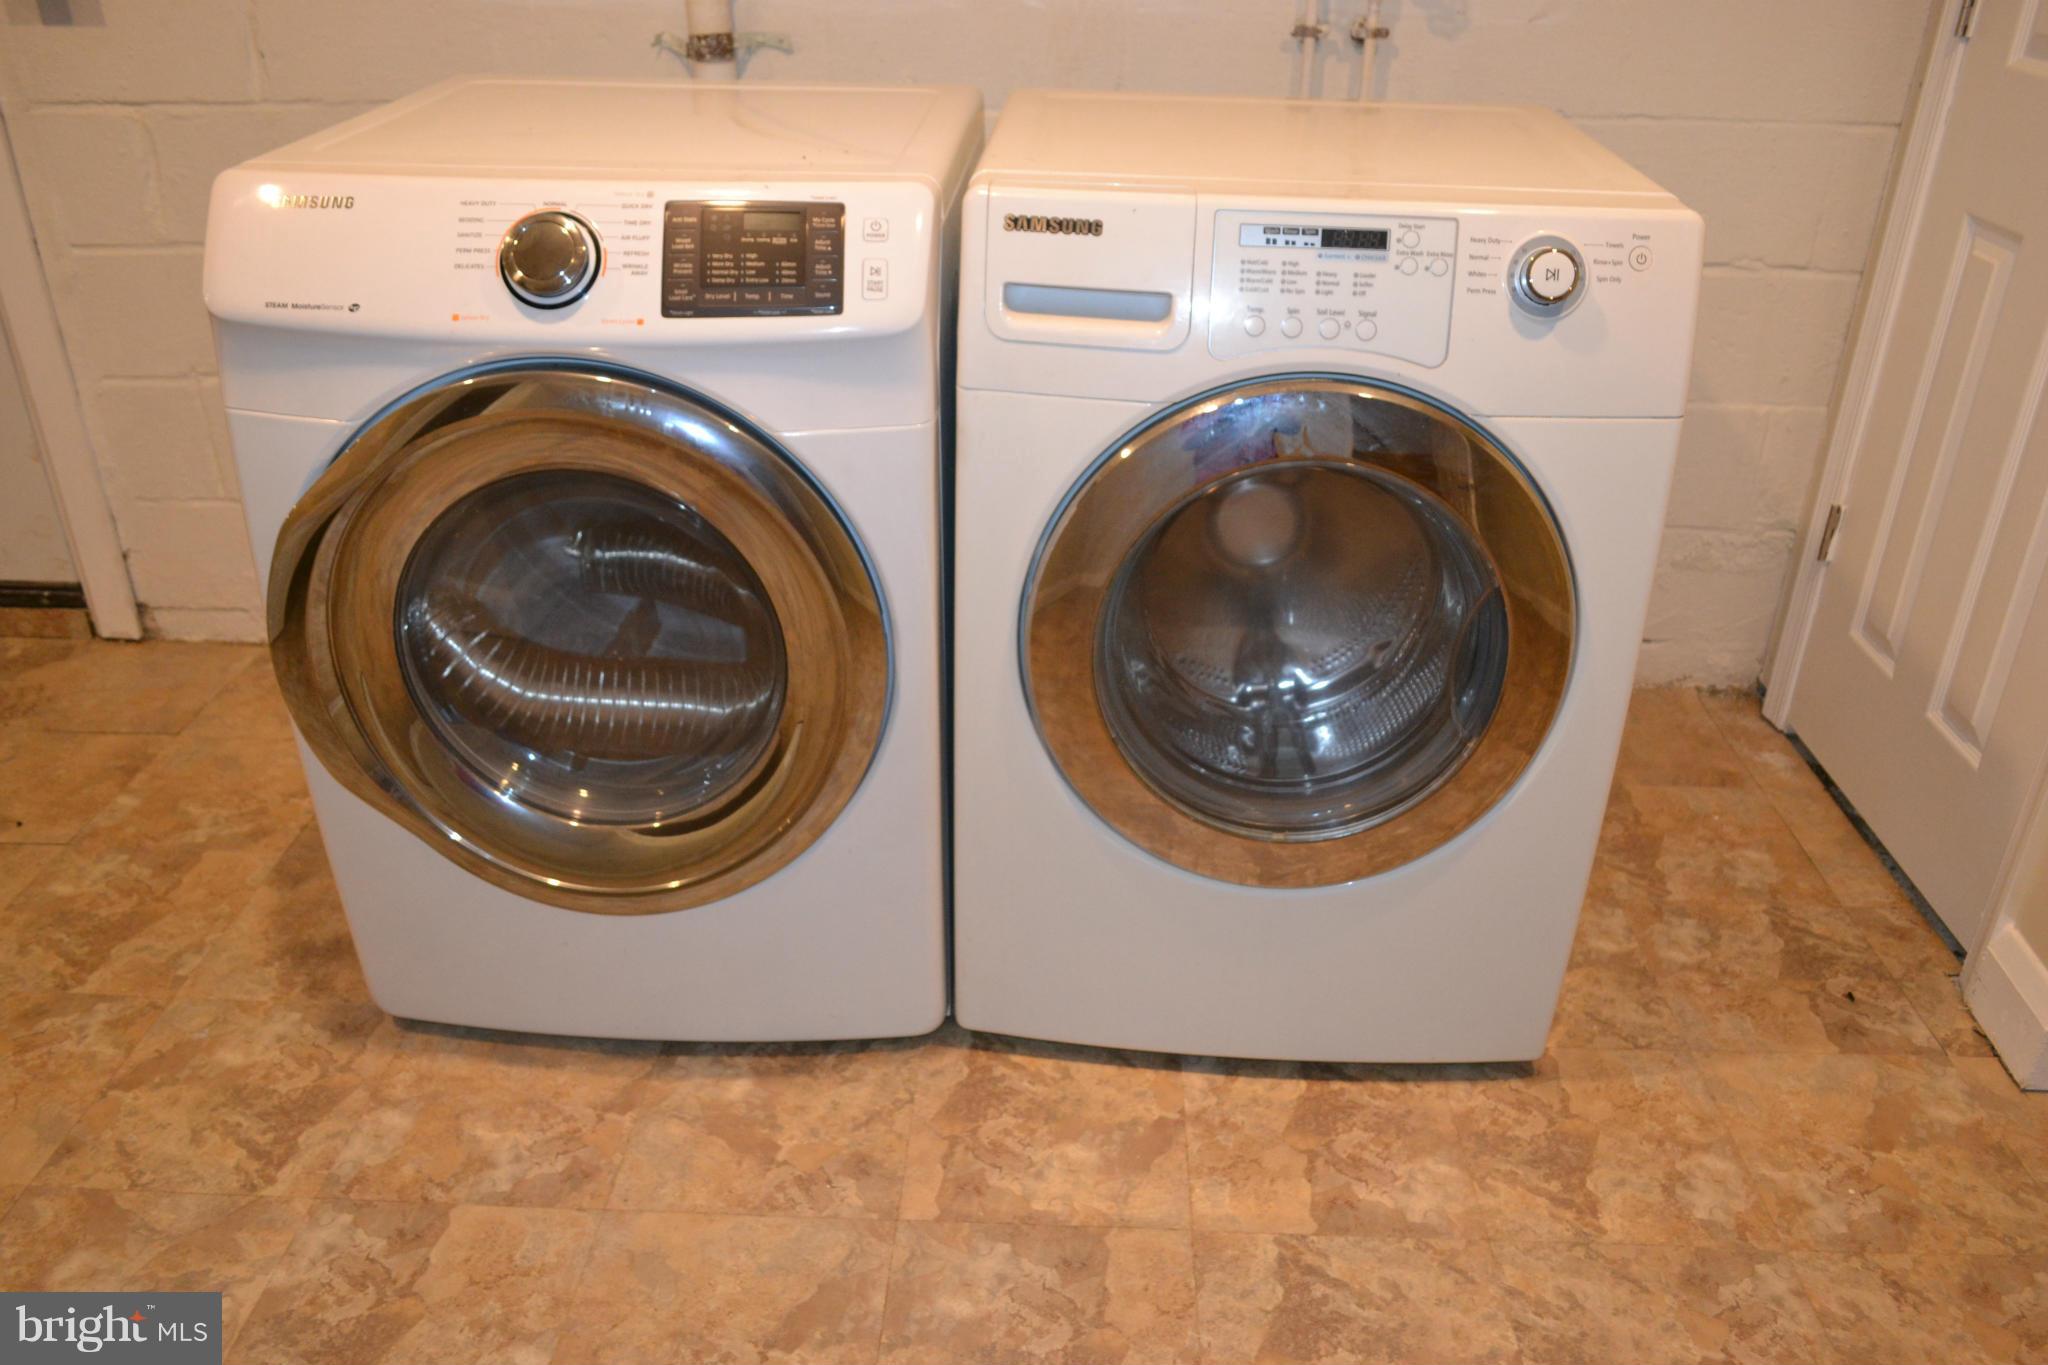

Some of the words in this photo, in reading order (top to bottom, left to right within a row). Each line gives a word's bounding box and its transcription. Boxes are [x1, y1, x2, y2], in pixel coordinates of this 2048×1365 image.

[271, 195, 354, 209] AMSUNG
[1003, 213, 1103, 236] SAMSUNG
[1470, 236, 1486, 244] Heavy
[1488, 236, 1501, 244] Duty
[1609, 276, 1622, 284] Only
